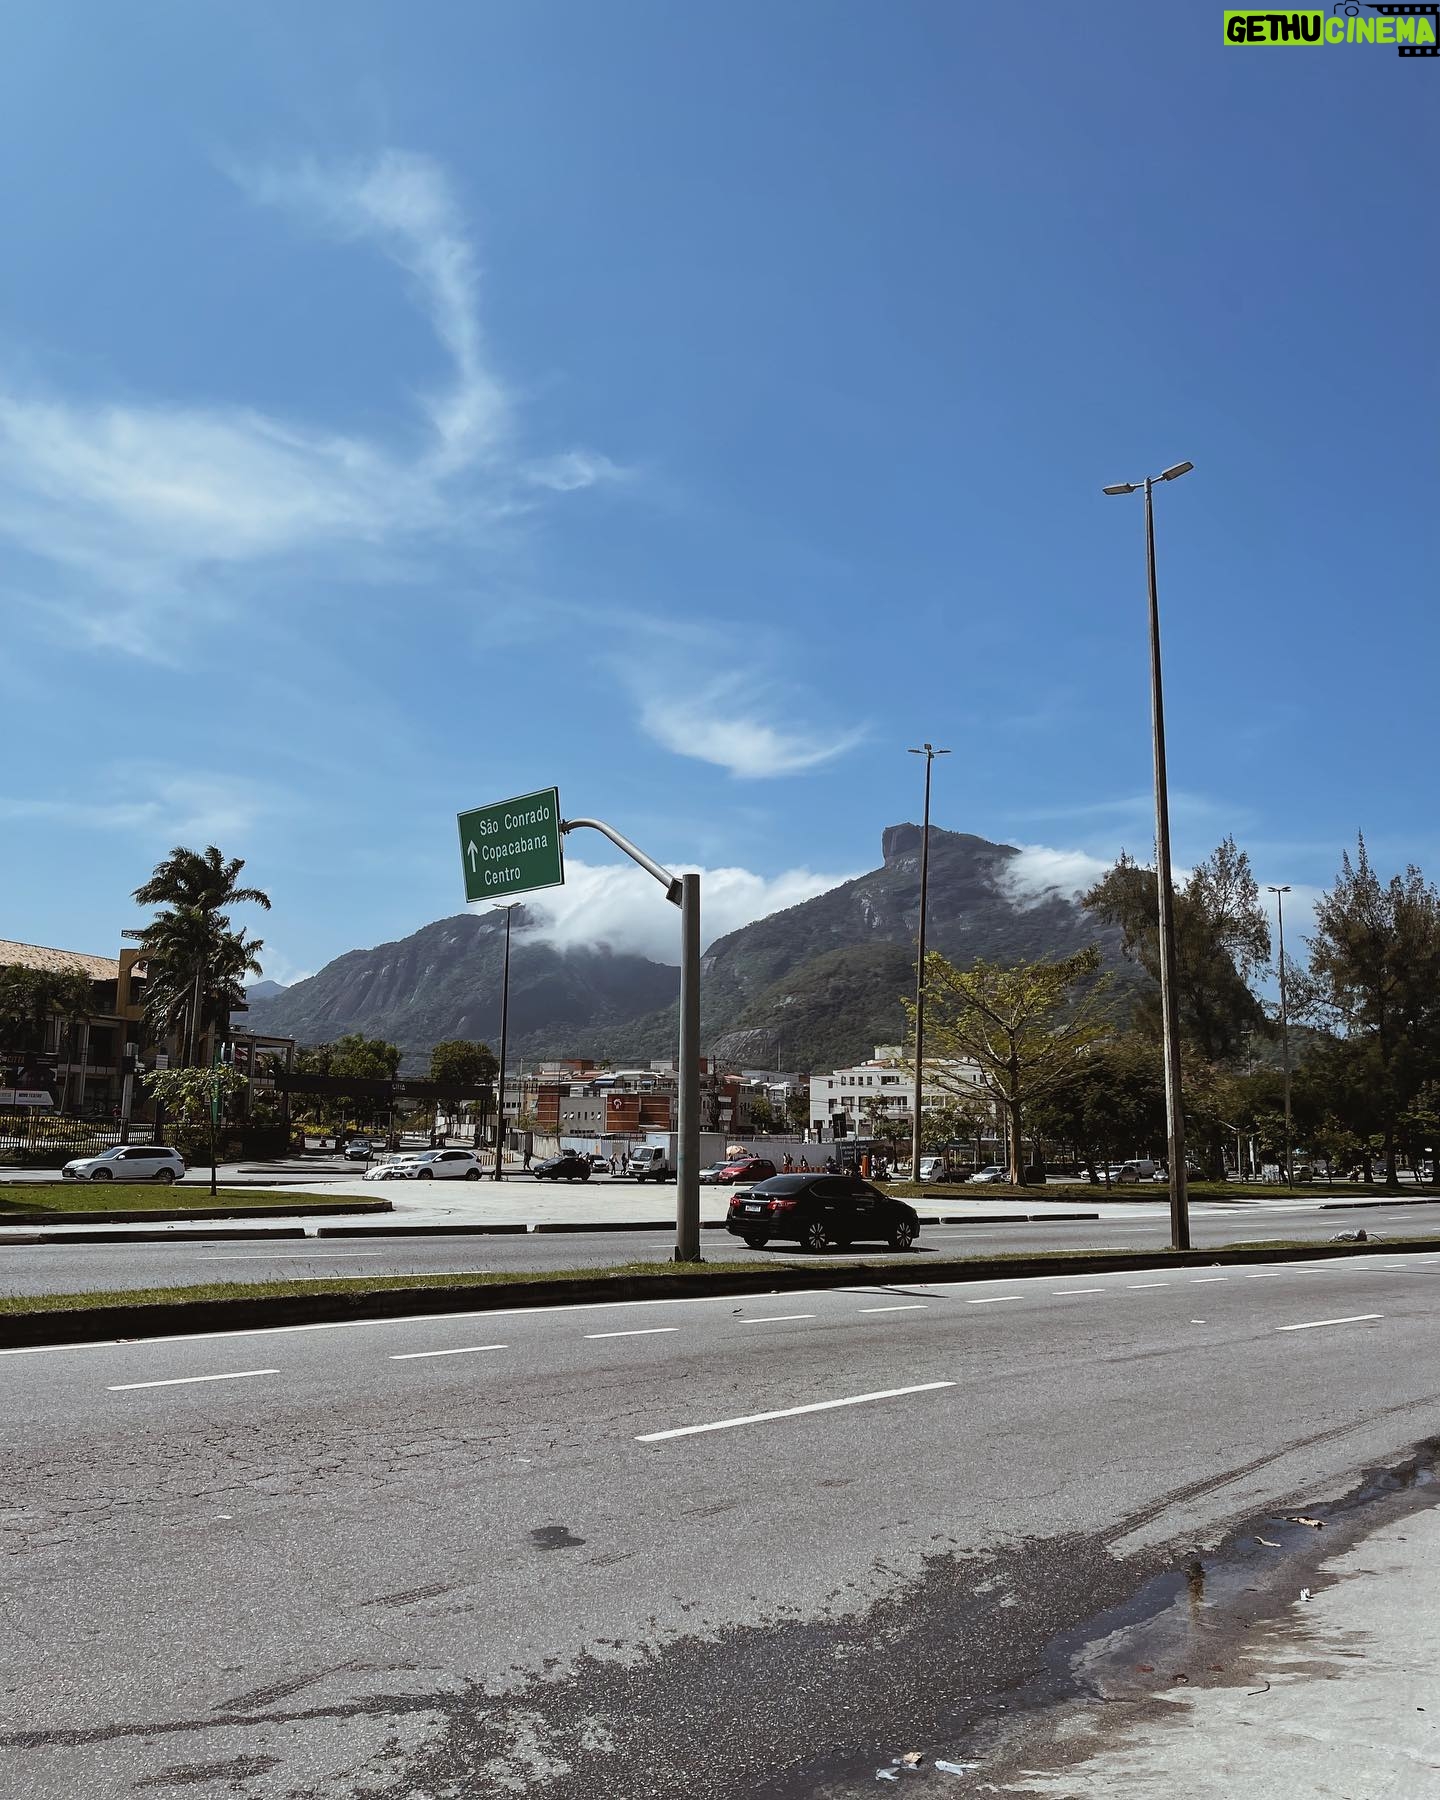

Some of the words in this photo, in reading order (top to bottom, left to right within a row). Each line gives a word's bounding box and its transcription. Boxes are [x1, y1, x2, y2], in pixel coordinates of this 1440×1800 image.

[480, 819, 499, 836] São
[504, 805, 550, 830] Conrado
[482, 835, 548, 862] Copacabana
[484, 867, 521, 886] Centro
